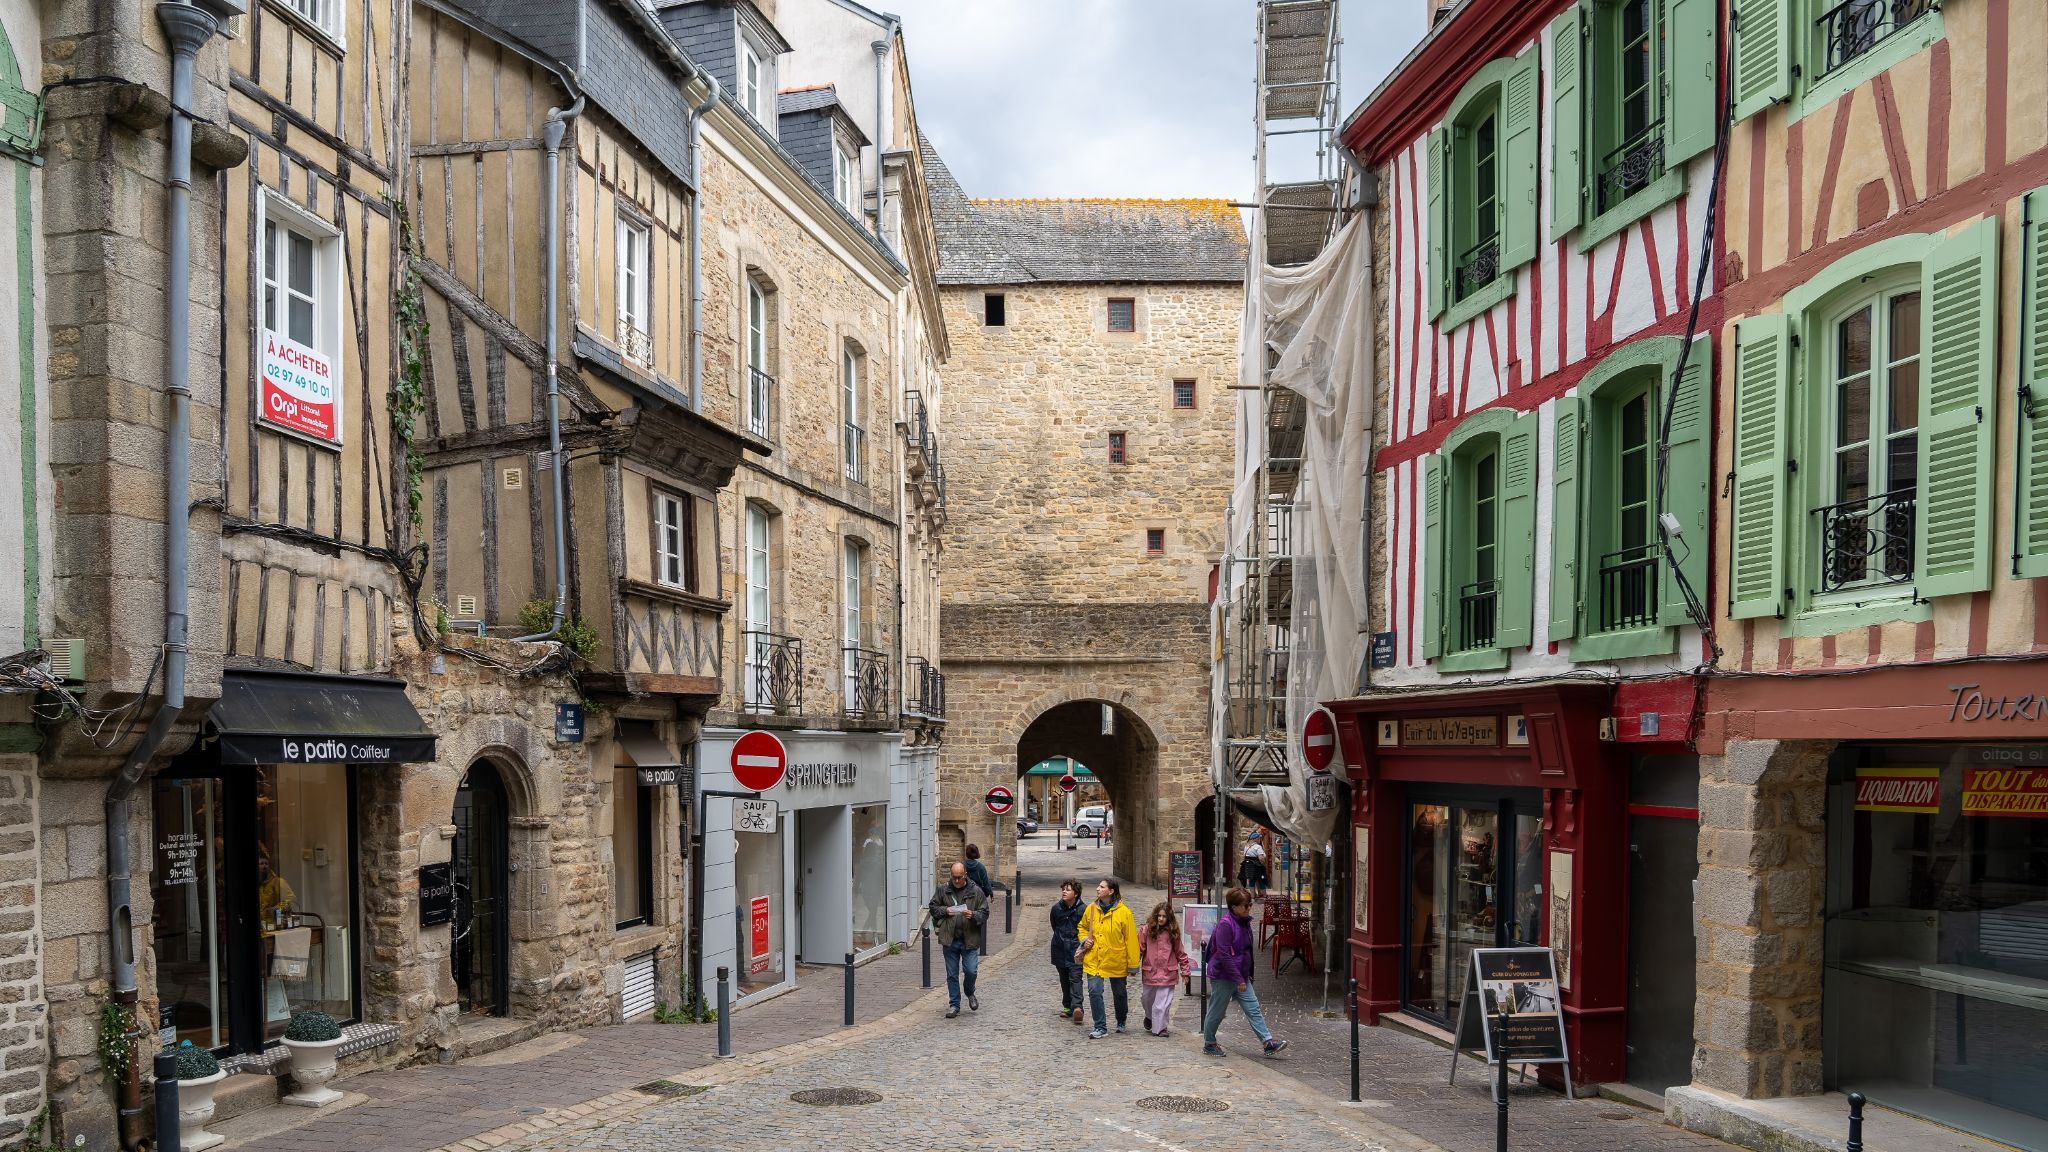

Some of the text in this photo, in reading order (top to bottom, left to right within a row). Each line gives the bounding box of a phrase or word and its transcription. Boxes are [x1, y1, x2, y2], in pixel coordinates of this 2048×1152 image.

[267, 335, 328, 378] À ACHETER
[267, 363, 330, 398] 02 97 49 10 01
[271, 392, 321, 418] Orpi Littoral
[300, 414, 329, 430] Immobilier
[1405, 723, 1424, 740] Cuir
[1427, 724, 1438, 740] du
[282, 738, 391, 763] le patio Coiffeur
[645, 769, 676, 784] le patio
[785, 761, 858, 788] SPRINGFIELD
[1971, 770, 2033, 791] TOUT
[1857, 780, 1938, 806] LIQUIDATION
[743, 801, 768, 812] SAUF
[167, 832, 199, 842] horaires
[169, 867, 195, 879] 9h-14h
